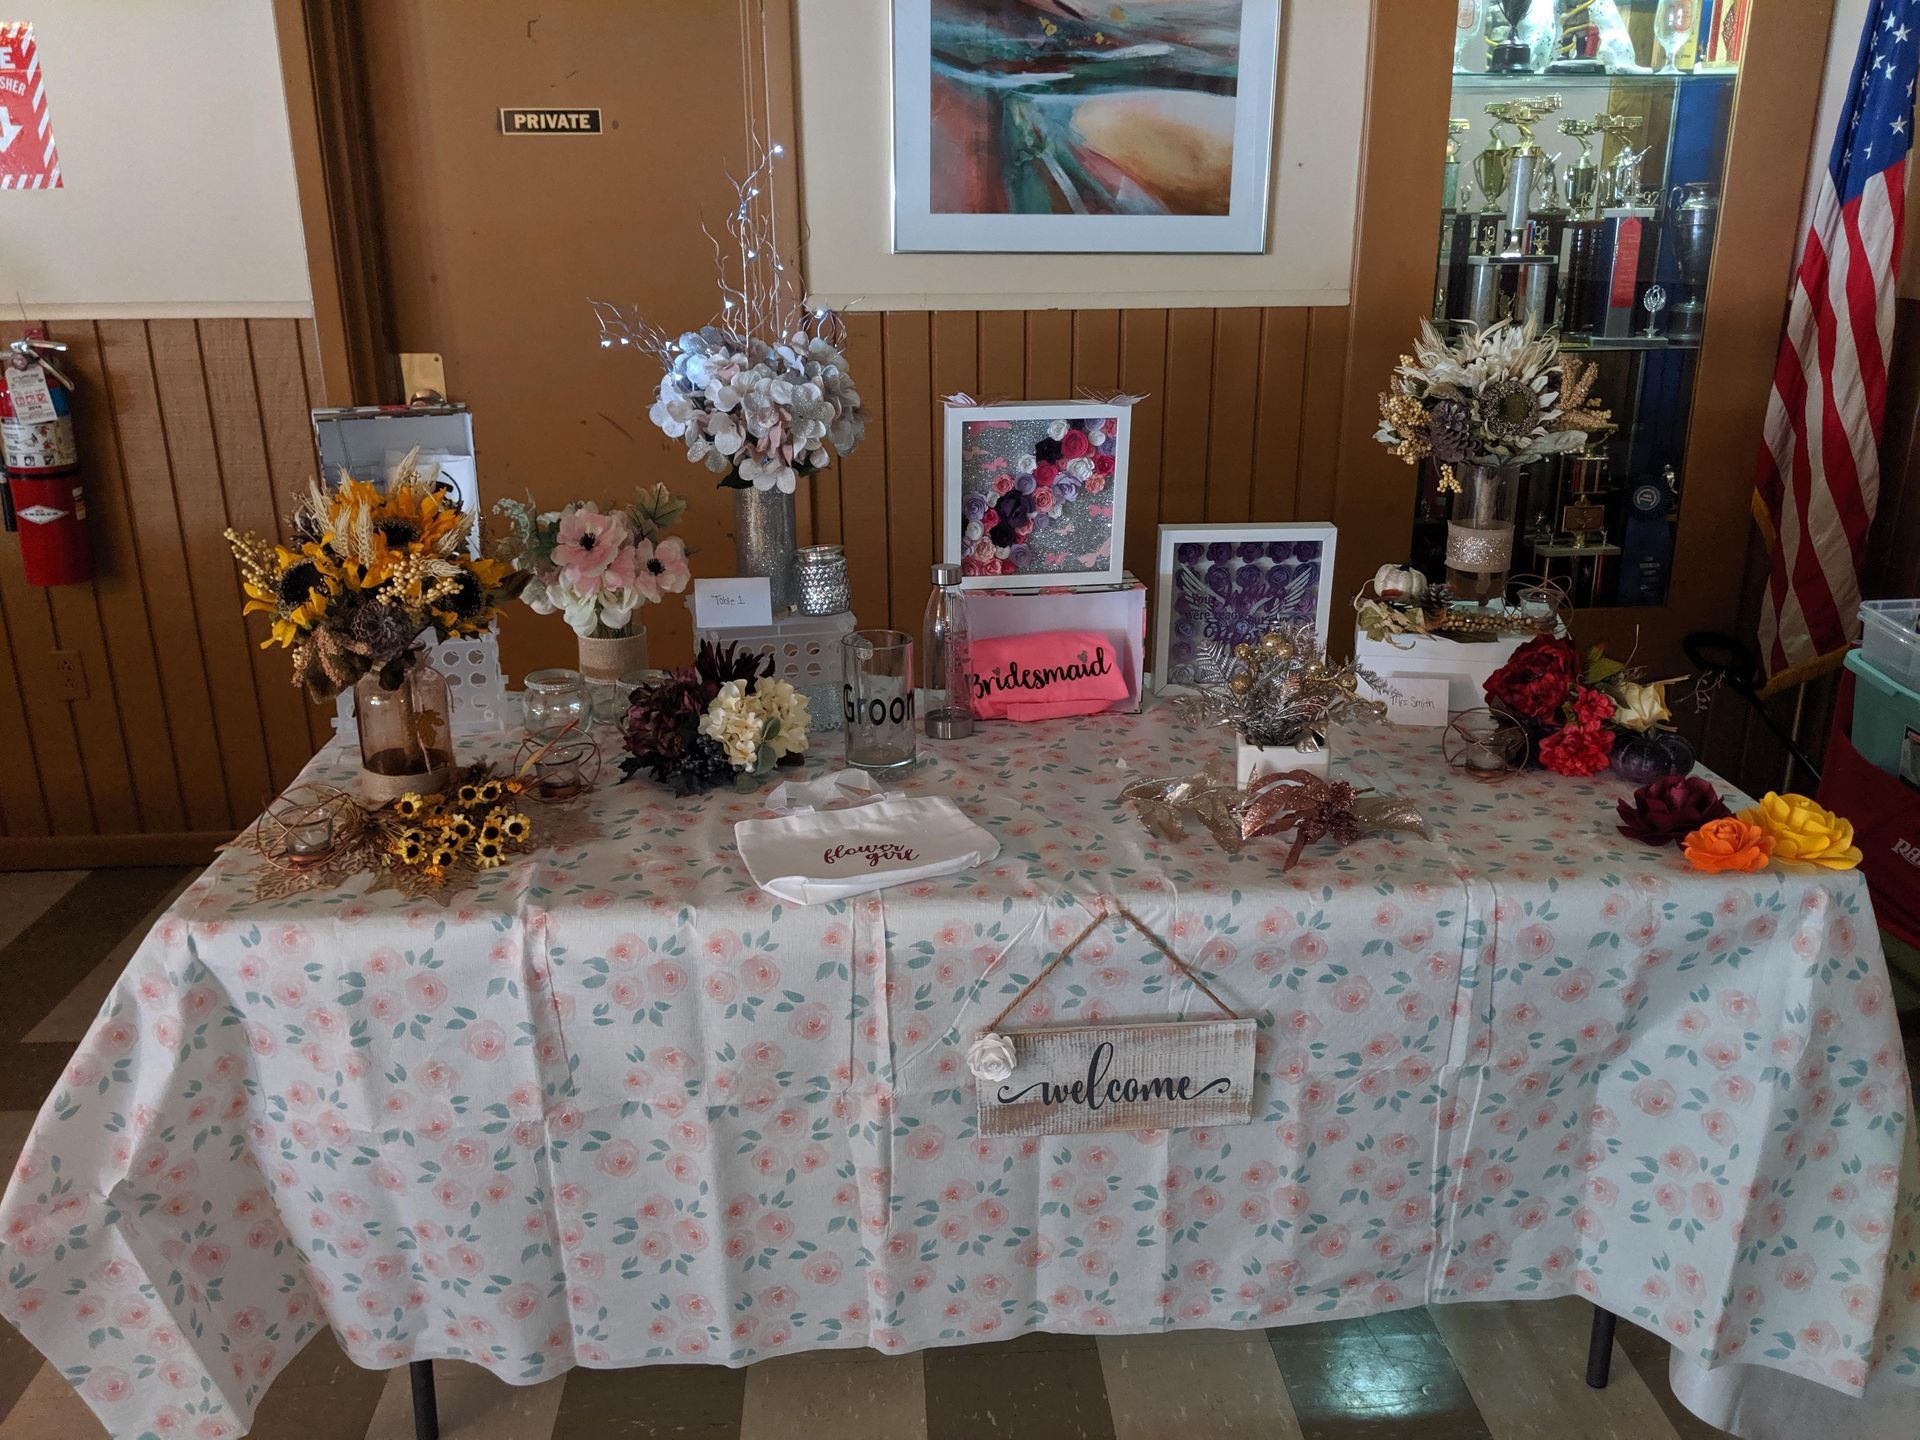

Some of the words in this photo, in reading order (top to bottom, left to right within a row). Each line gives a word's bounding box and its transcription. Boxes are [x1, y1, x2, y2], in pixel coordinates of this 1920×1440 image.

[513, 113, 592, 129] PRIVATE
[1482, 225, 1496, 242] 19
[711, 594, 735, 606] Table
[737, 595, 746, 605] 1
[964, 647, 1112, 699] Bridesmaid
[1411, 696, 1435, 709] Smith
[824, 844, 904, 864] flower
[866, 849, 919, 867] girl
[997, 1042, 1231, 1110] welcome
